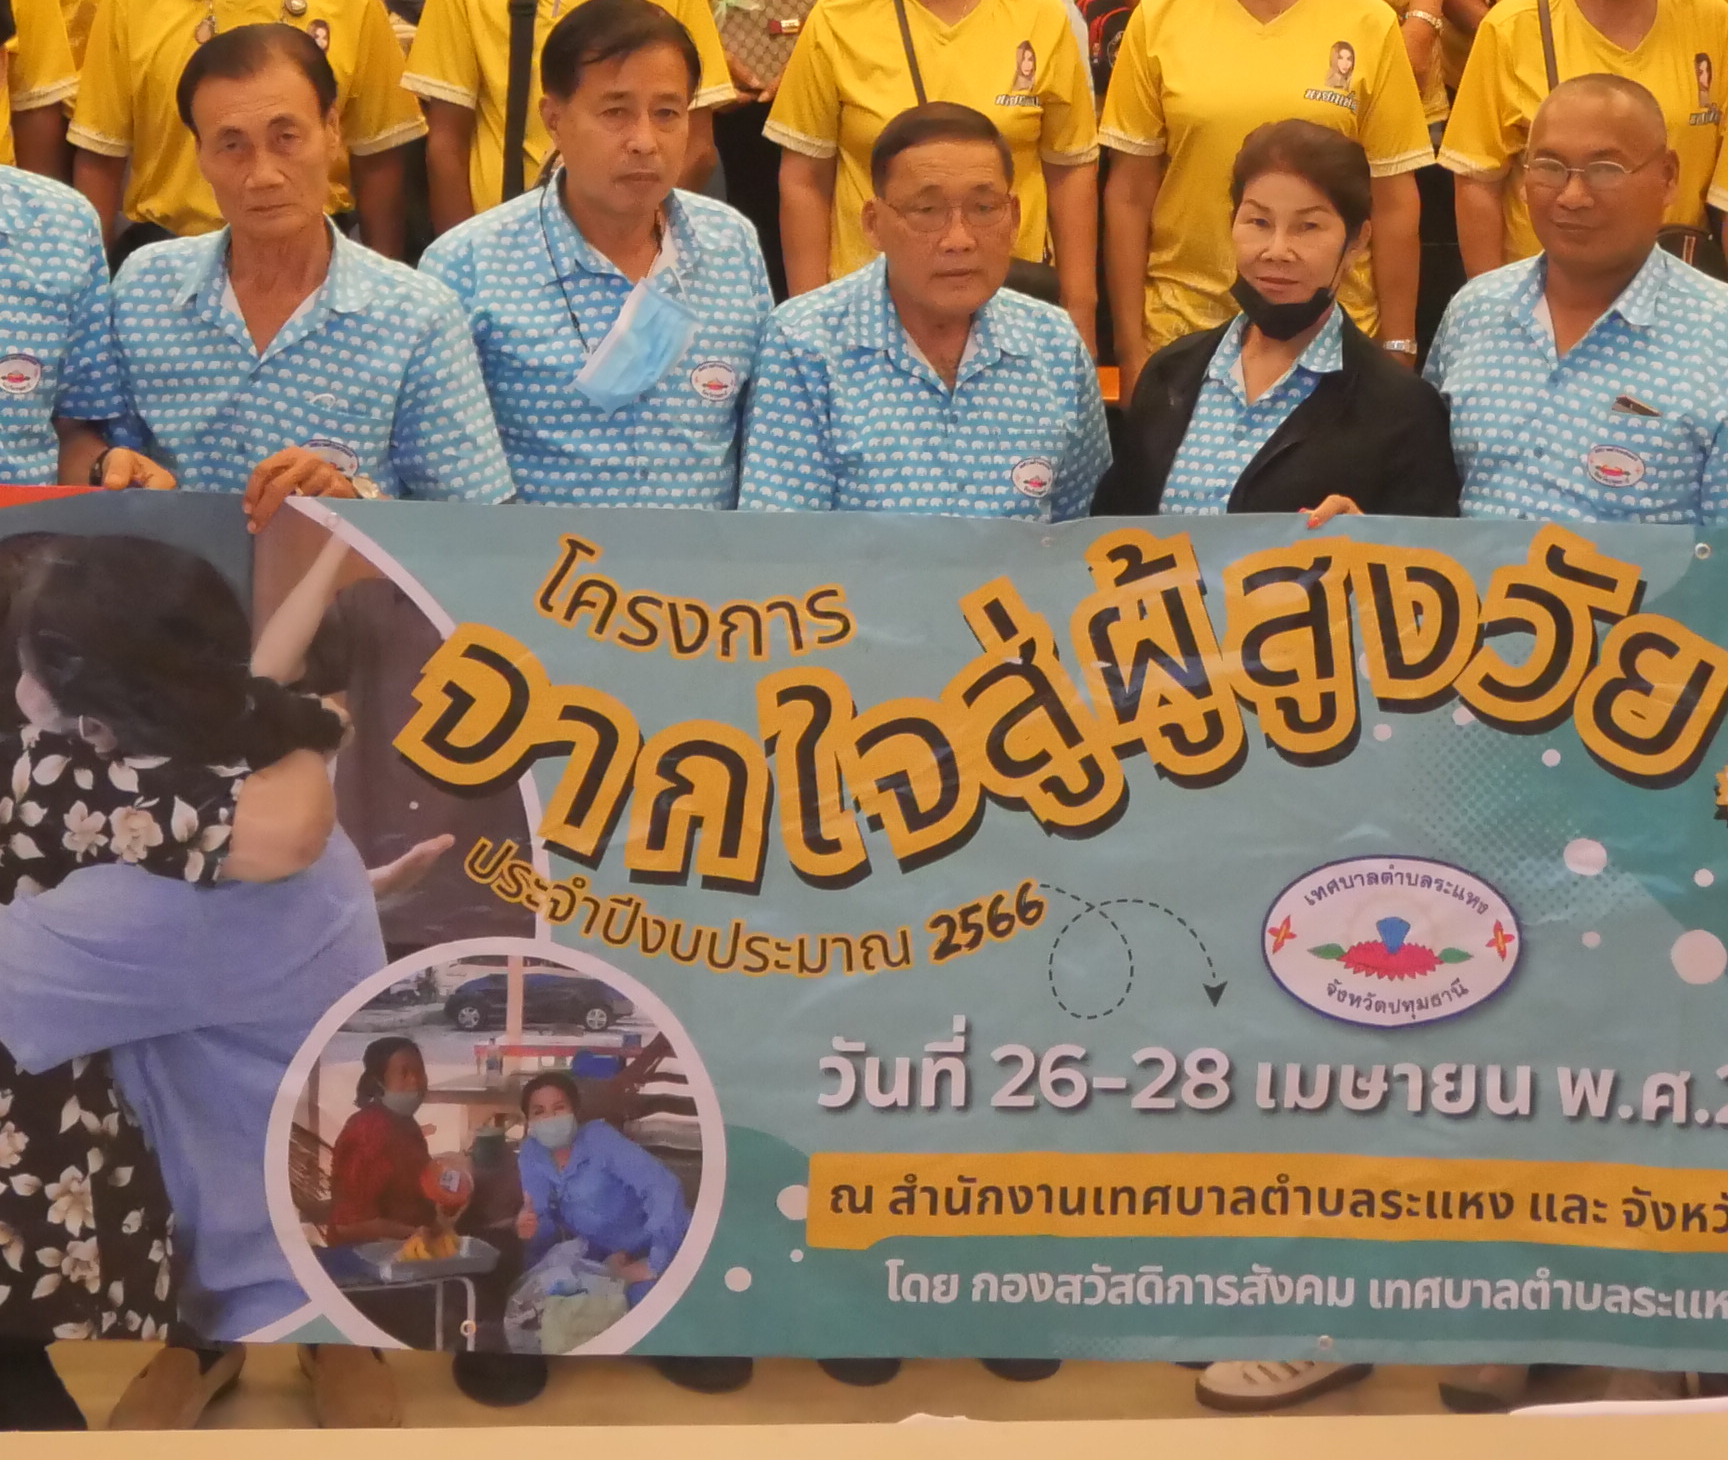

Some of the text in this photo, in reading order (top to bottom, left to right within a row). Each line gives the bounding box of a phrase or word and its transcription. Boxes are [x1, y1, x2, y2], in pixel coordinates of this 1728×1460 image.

[539, 537, 852, 657] โครงการ
[408, 534, 1728, 882] จากใจสู่ผู้สูงวัย
[470, 840, 1045, 974] ประจำปีงบประมาณ 2566
[1303, 864, 1489, 915] เทศบาลตำบลระแหง
[1326, 977, 1469, 1020] จังหวัดปทุมธานี
[817, 1014, 966, 1108] วันที่
[990, 1044, 1230, 1110] 26-28
[1256, 1060, 1532, 1117] เมษายน
[829, 1183, 874, 1216] ณ
[887, 1173, 1515, 1222] สำนักงานเทศบาลตำบลระแหง
[1528, 1191, 1608, 1225] และ
[884, 1259, 960, 1304] โดย
[971, 1263, 1357, 1308] กองสวัสดิการสังคม
